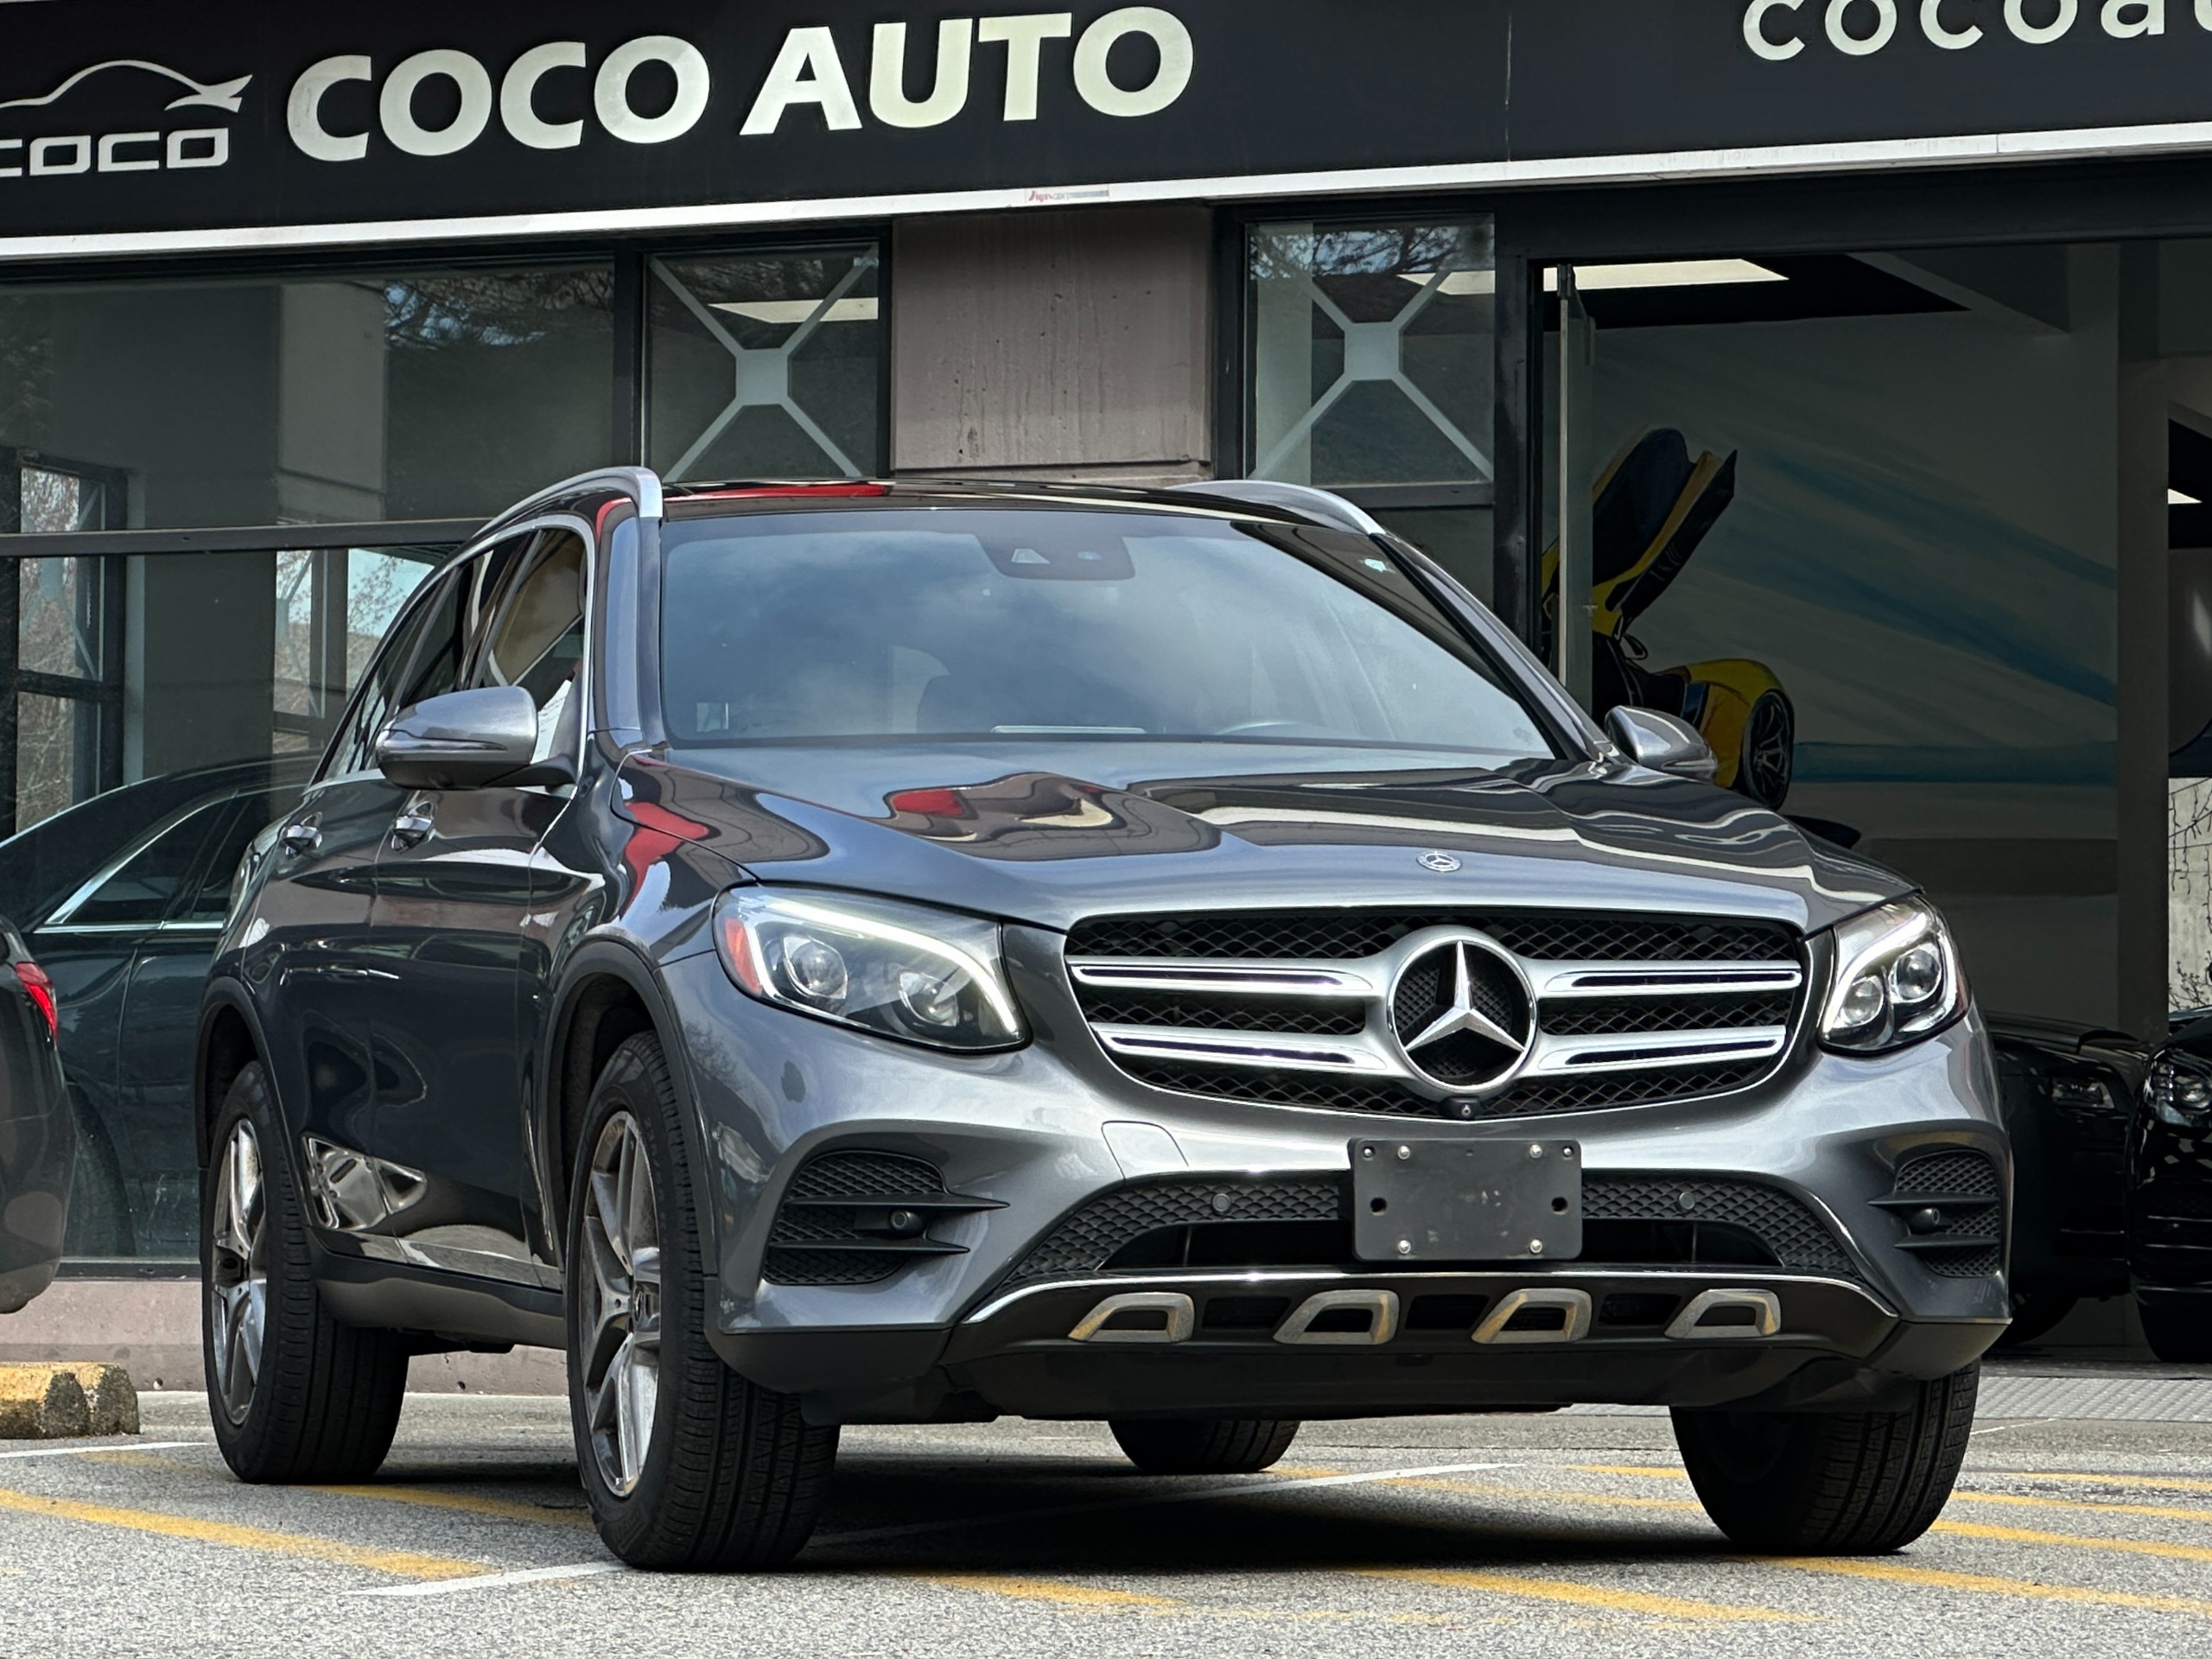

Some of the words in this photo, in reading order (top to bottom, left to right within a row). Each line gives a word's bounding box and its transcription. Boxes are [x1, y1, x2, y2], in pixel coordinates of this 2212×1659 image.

[287, 35, 710, 162] COCO
[739, 6, 1194, 136] AUTO
[1743, 0, 2212, 61] cocoa
